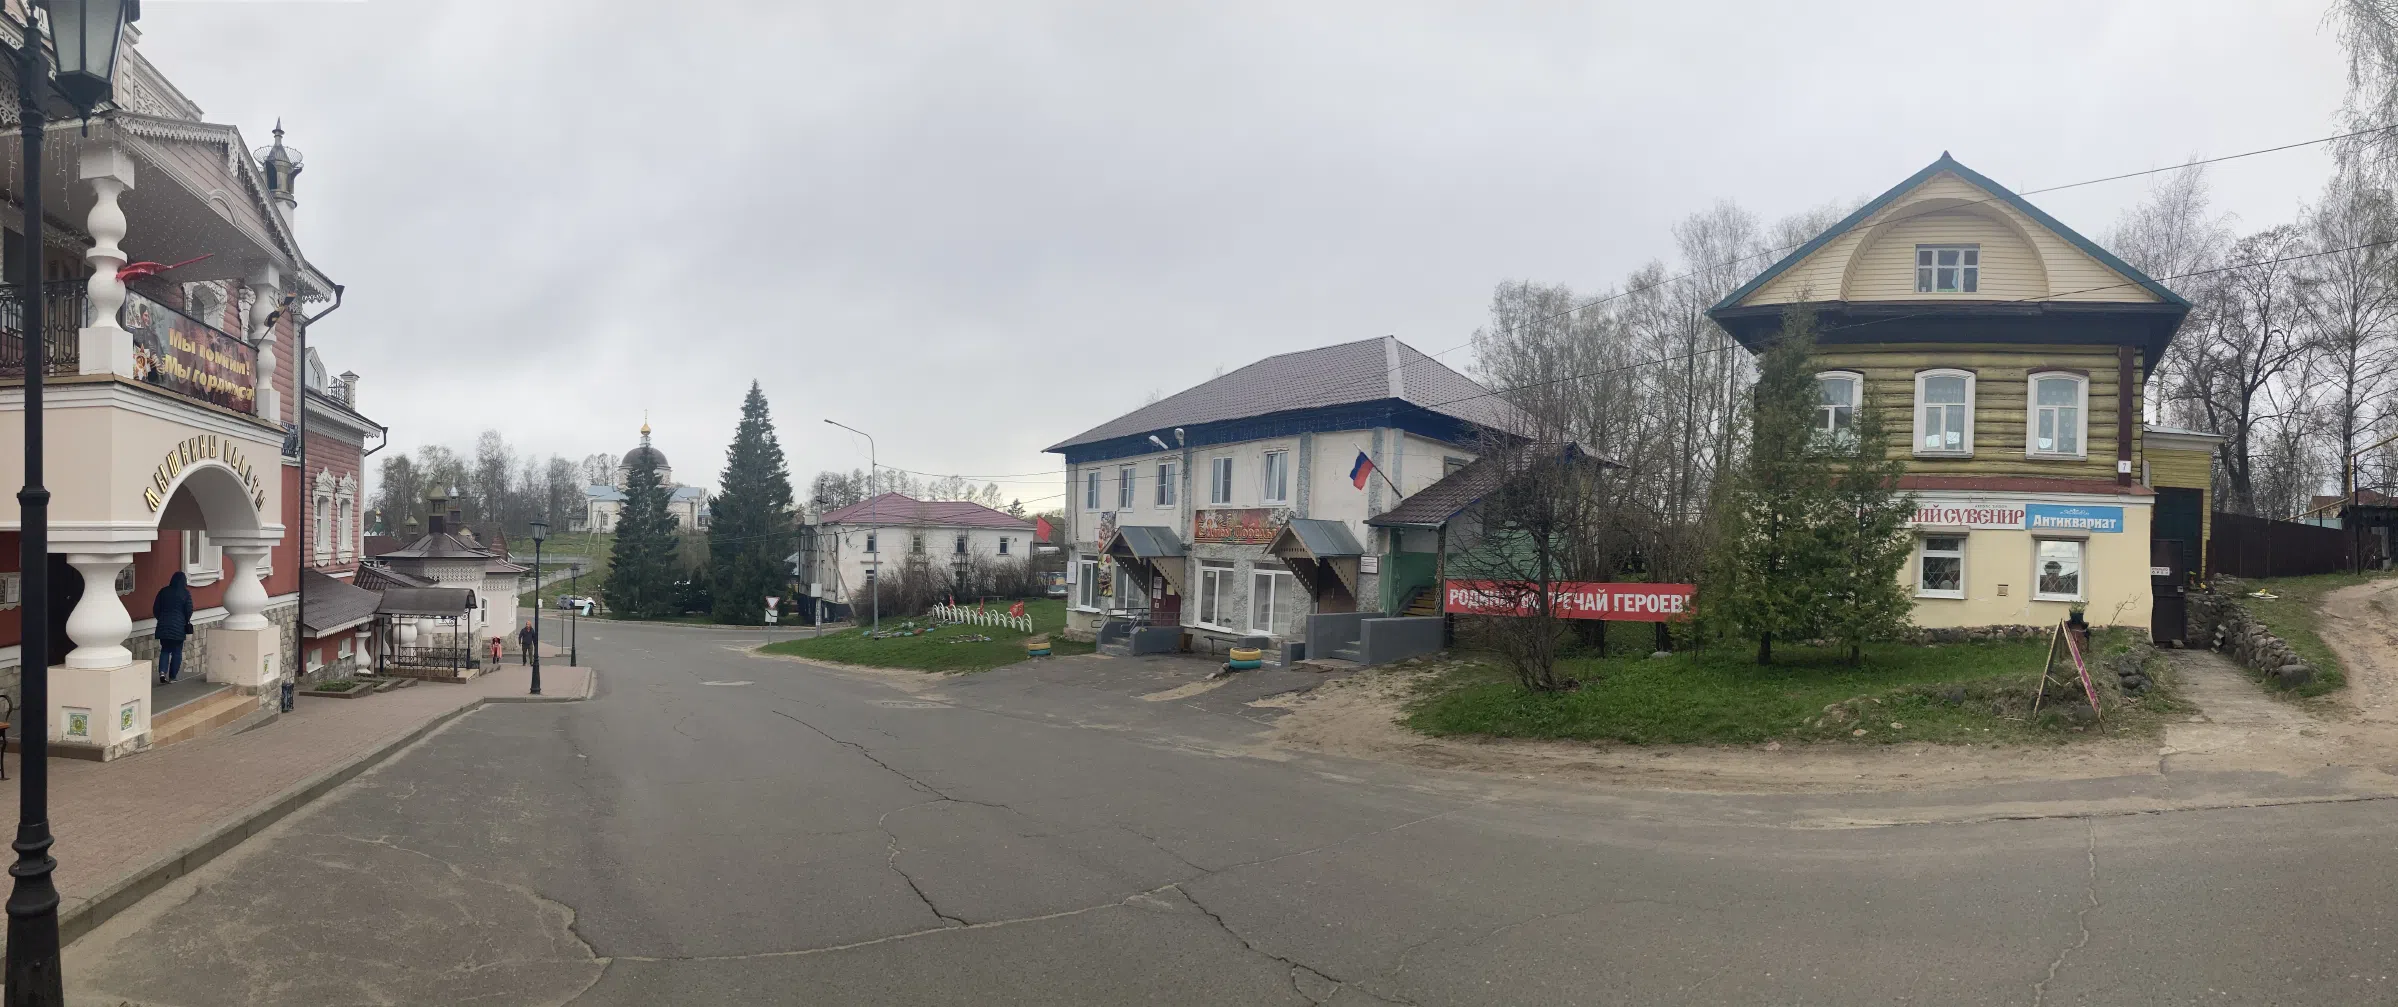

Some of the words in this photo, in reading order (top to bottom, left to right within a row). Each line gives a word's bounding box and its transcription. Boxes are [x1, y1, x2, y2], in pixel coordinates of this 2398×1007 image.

[169, 328, 196, 355] Мы
[199, 344, 250, 376] помним!
[164, 354, 191, 380] Мы
[192, 369, 255, 401] гордимся!
[1944, 507, 2025, 526] СУВЕНИР
[2033, 514, 2116, 530] Антиквариат
[1613, 592, 1691, 614] ГЕРОЕВ!
